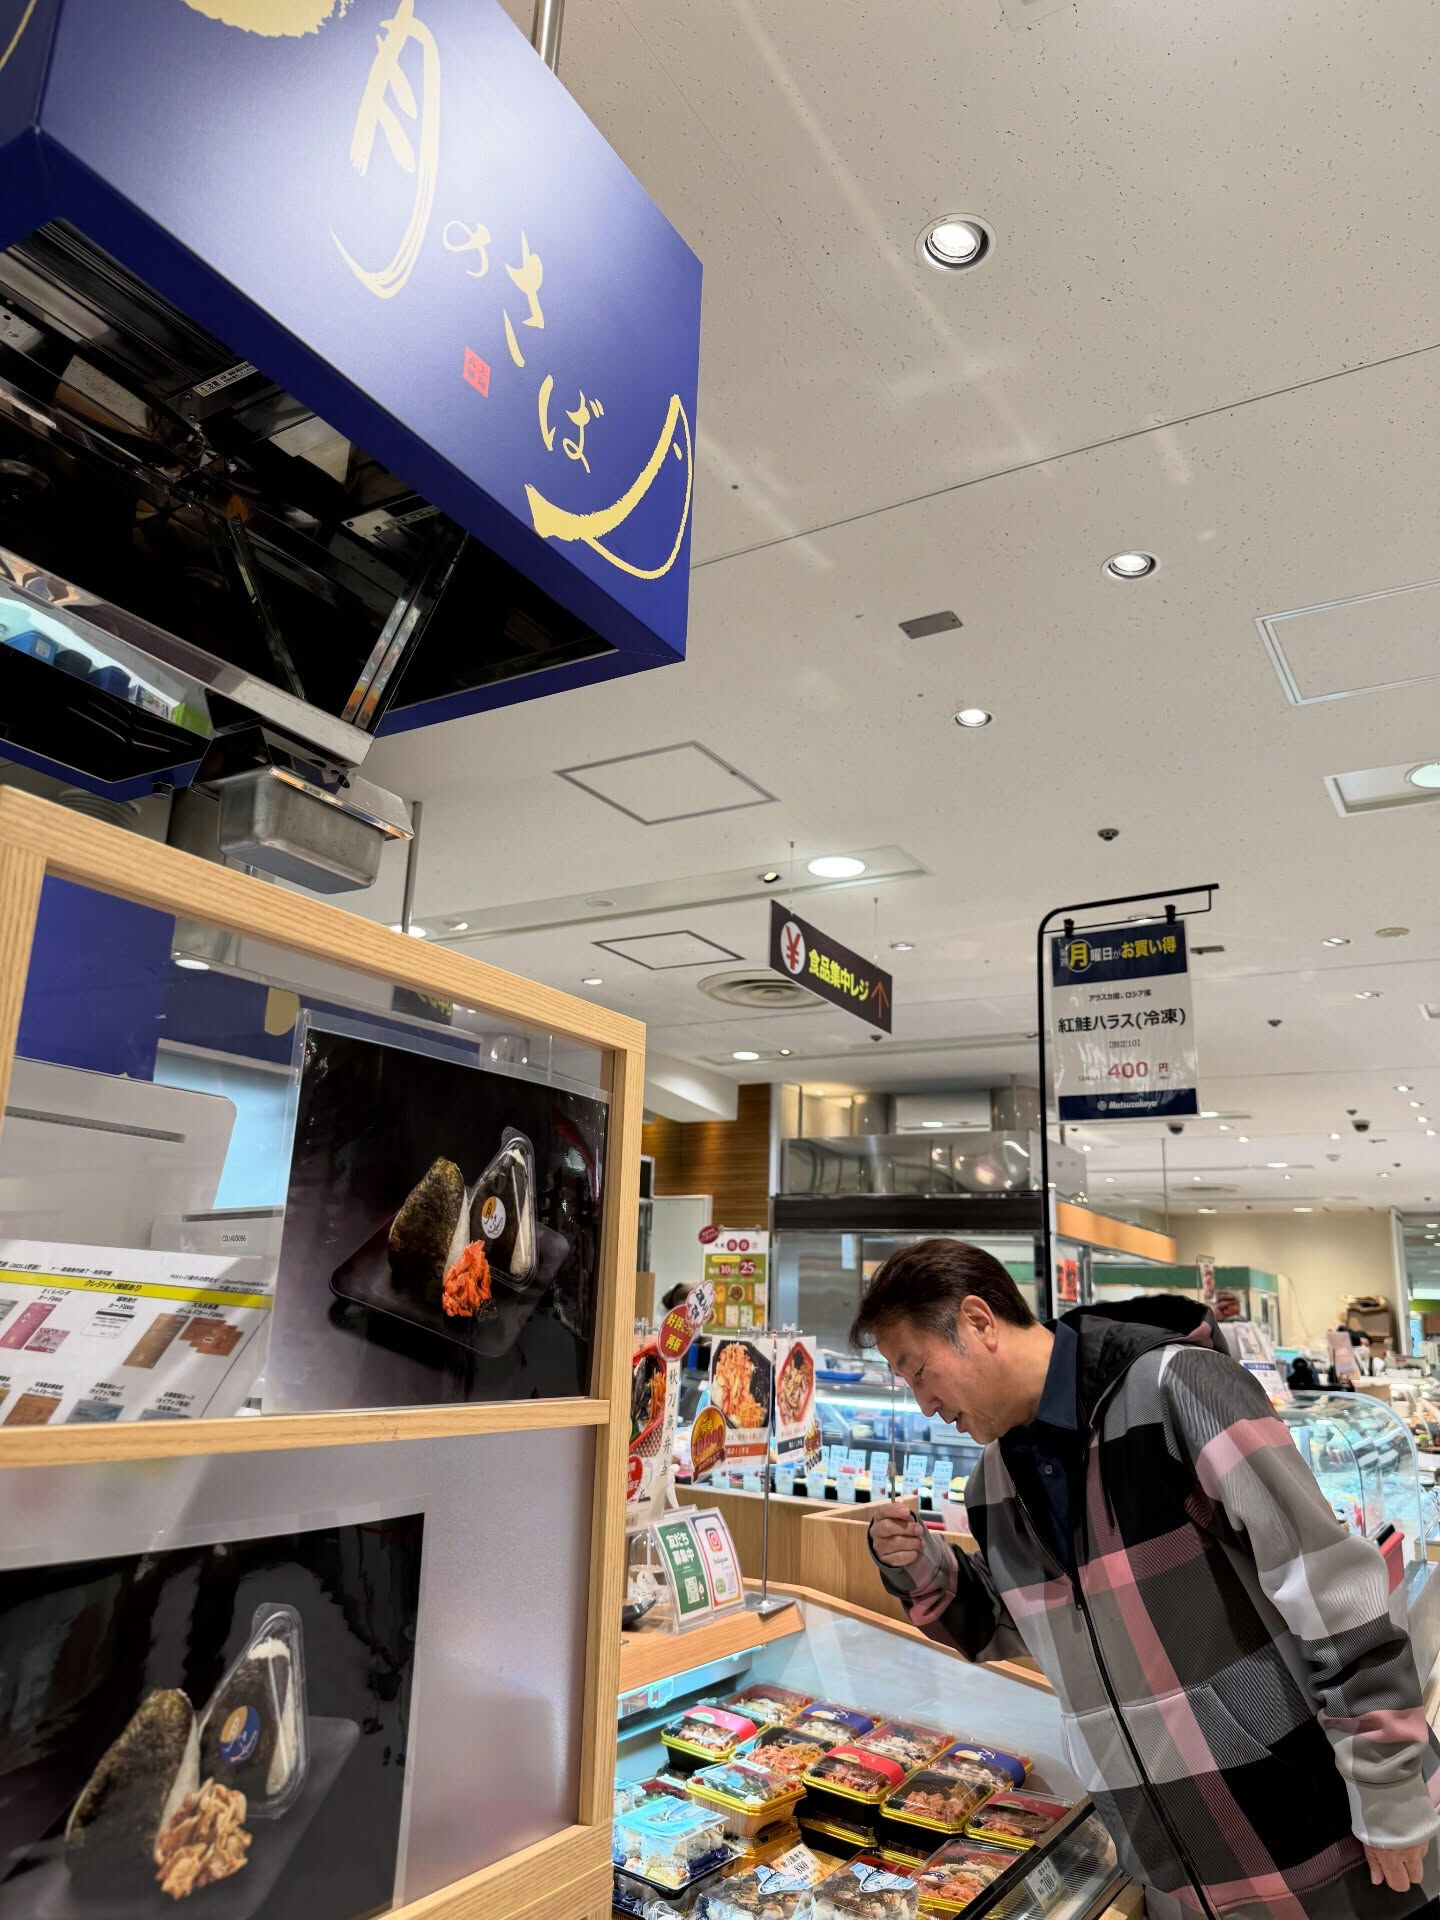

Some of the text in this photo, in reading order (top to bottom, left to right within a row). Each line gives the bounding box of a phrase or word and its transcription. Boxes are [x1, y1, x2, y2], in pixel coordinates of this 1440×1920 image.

[808, 949, 870, 1001] 食品集中レジ
[1107, 1061, 1148, 1078] 400
[1158, 1062, 1168, 1073] 円
